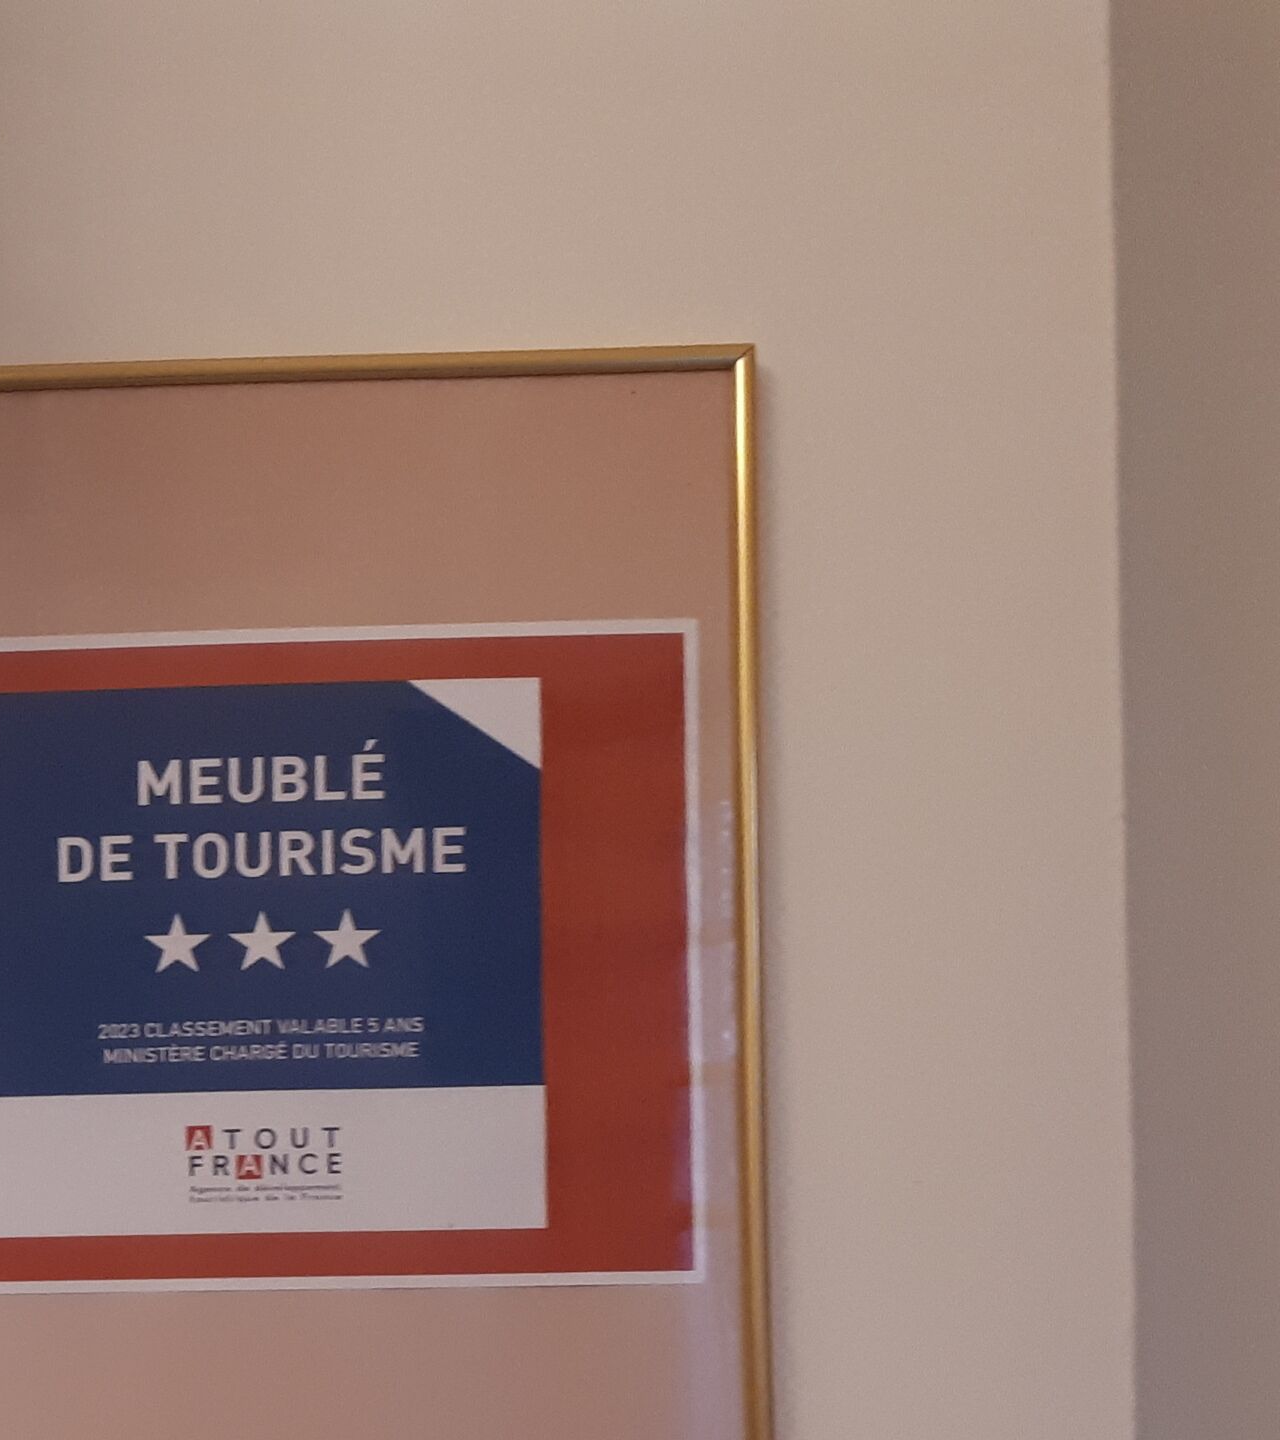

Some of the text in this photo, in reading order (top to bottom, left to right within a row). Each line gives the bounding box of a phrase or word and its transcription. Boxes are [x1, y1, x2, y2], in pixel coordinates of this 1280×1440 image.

[137, 739, 386, 806] MEUBLÉ
[57, 826, 467, 883] DE TOURISME
[97, 1016, 425, 1039] 2023 CLASSEMENT VALABLE 5 ANS
[102, 1041, 420, 1064] MINISTÈRE CHARGÉ DU TOURISME
[186, 1126, 340, 1150] ATOUT
[188, 1153, 342, 1178] FRANCE
